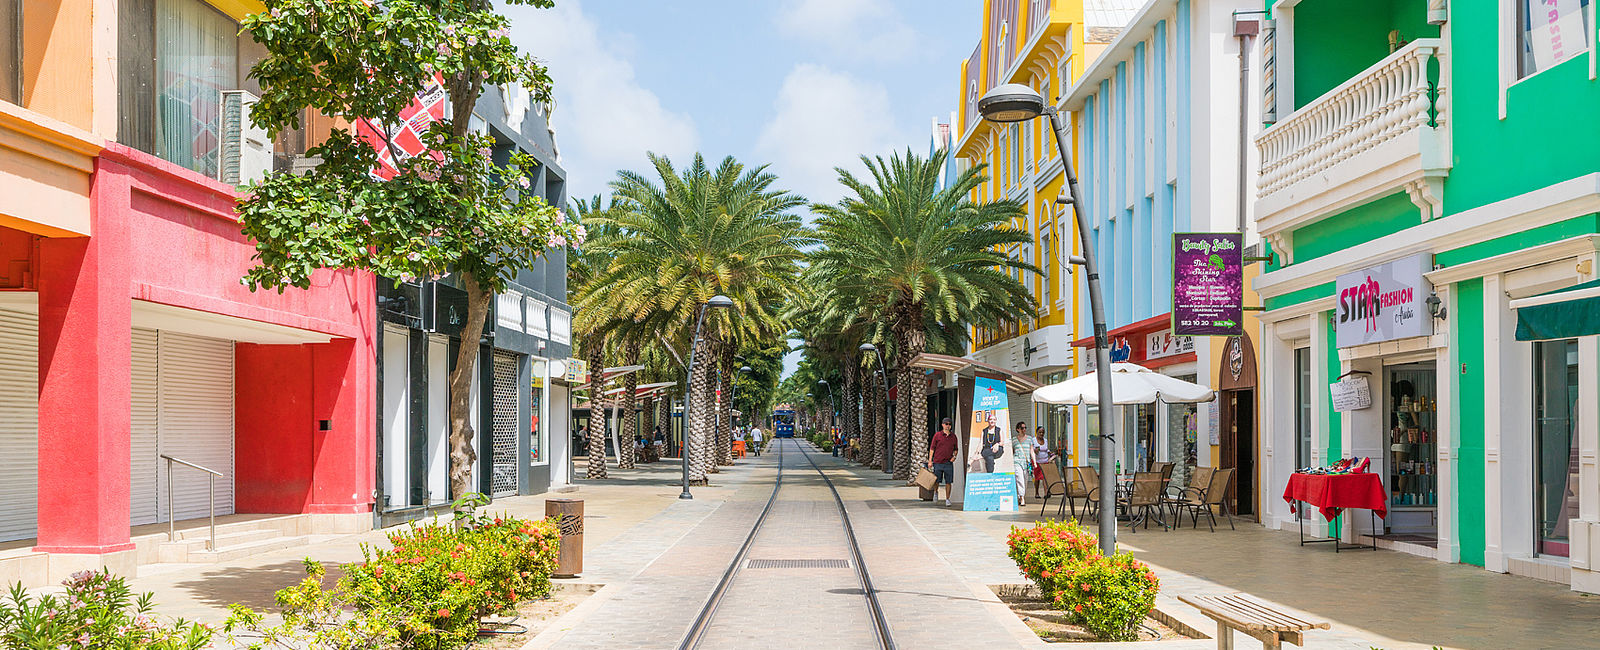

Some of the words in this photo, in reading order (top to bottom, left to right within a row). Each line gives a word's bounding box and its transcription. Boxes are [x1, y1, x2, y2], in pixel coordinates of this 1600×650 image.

[1182, 239, 1211, 255] Beauty
[1192, 269, 1220, 277] Shining
[1380, 287, 1413, 309] FASHION
